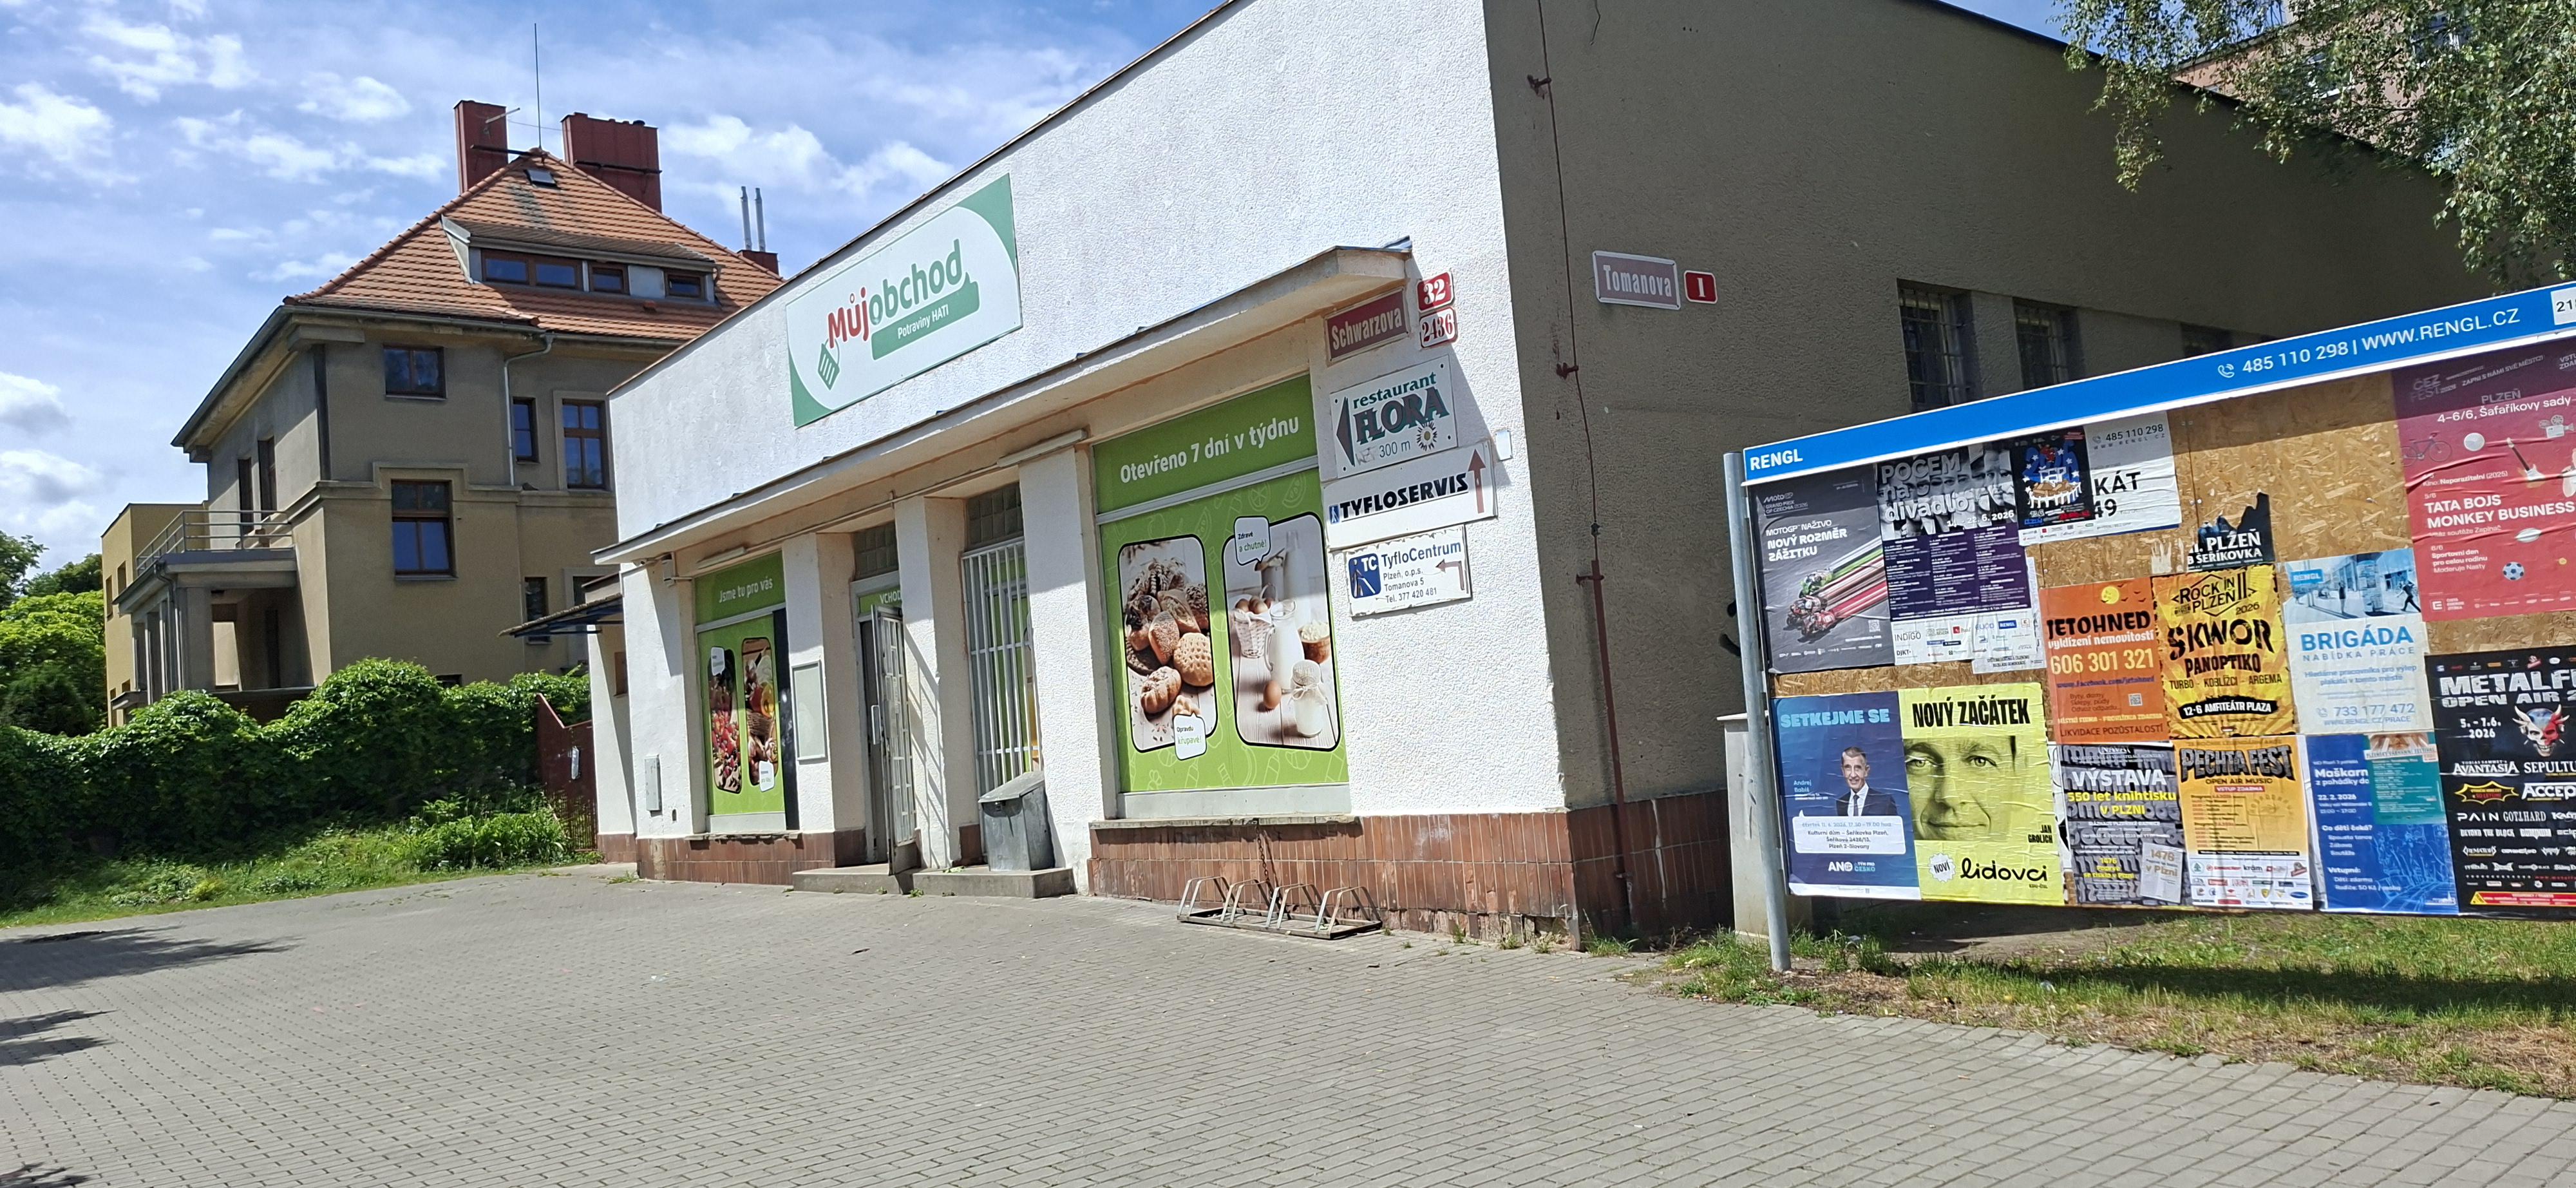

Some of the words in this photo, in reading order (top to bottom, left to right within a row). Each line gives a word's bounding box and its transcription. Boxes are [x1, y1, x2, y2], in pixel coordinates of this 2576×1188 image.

[1603, 265, 1672, 297] Tomanova
[1423, 279, 1446, 305] 32
[2557, 299, 2576, 312] 21
[898, 311, 930, 339] Potraviny
[932, 304, 949, 323] HATI
[1331, 308, 1402, 350] Schwarzova
[1421, 313, 1454, 342] 2436
[2242, 355, 2273, 374] 485
[2280, 348, 2311, 368] 110
[2316, 341, 2349, 361] 298
[2362, 307, 2520, 351] WWW.RENGL.CZ
[2505, 362, 2518, 372] SVÉ
[1353, 372, 1437, 409] restaurant
[2413, 374, 2441, 390] ČEZ
[2481, 388, 2521, 404] PLZEŇ
[2479, 401, 2539, 417] Šafaříkovy
[2543, 395, 2571, 407] sady
[1352, 387, 1450, 445] FLORA
[2105, 432, 2123, 442] 485
[2126, 428, 2143, 437] 110
[2146, 423, 2164, 434] 298
[1120, 448, 1188, 483] Otevřeno
[1191, 443, 1200, 463] 7
[1204, 434, 1229, 459] dní
[1234, 434, 1244, 450] v
[1249, 416, 1299, 448] týdnu
[1379, 442, 1397, 457] 300
[1401, 441, 1410, 452] m
[1750, 449, 1803, 471] RENGL
[2094, 470, 2141, 496] KÁT
[1340, 472, 1468, 519] TYFLOSERVIS
[1885, 483, 1910, 501] na
[1884, 492, 1969, 522] divadlo
[2424, 499, 2461, 513] TATA
[2463, 494, 2502, 510] BOJS
[1991, 510, 2015, 521] 2026
[2427, 510, 2494, 529] MONKEY
[2498, 501, 2575, 521] BUSINESS
[1801, 519, 1832, 532] NAŽIVO
[1767, 534, 1797, 550] NOVÝ
[1800, 527, 1848, 544] ROZMĚR
[2206, 528, 2262, 551] PLZEŇ
[1381, 542, 1462, 570] TyfloCentrum
[1768, 546, 1817, 562] ZÁŽITKU
[2196, 547, 2262, 564] ŠEŘÍKOVKA
[1361, 555, 1378, 571] TC
[1405, 568, 1423, 578] o.p.s.
[719, 585, 737, 604] Jsme
[738, 584, 746, 598] tu
[747, 581, 759, 599] pro
[760, 576, 773, 591] vás
[1385, 580, 1419, 592] Tomanova
[2179, 581, 2220, 604] ROCK
[1386, 594, 1397, 604] Tel.
[1399, 592, 1410, 602] 377
[1412, 590, 1424, 599] 420
[1426, 587, 1437, 597] 481
[2235, 602, 2260, 616] 2026
[2047, 610, 2151, 640] JETOHNED
[1895, 631, 1922, 642] INDIGO
[2048, 635, 2092, 650] vyklízení
[2094, 629, 2154, 646] nemovitostí
[2300, 624, 2414, 652] BRIGÁDA
[2050, 653, 2083, 675] 606
[2088, 651, 2118, 673] 301
[2124, 647, 2154, 669] 321
[2302, 651, 2362, 662] NABÍDKA
[2370, 646, 2415, 657] PRÁCE
[2184, 653, 2262, 678] PANOPTIKO
[2382, 666, 2395, 675] pro
[2170, 680, 2194, 690] TURBO
[2248, 673, 2282, 685] ARGEMA
[2439, 669, 2576, 696] METALF
[2204, 699, 2246, 713] AMFITEÁTR
[2246, 701, 2272, 713] PLAZA
[2442, 694, 2508, 708] OPEN
[2516, 691, 2561, 704] AIR
[1780, 709, 1865, 728] SETKEJME
[1868, 708, 1890, 723] SE
[1912, 696, 1954, 728] NOVÝ
[1957, 694, 2031, 725] ZAČÁTEK
[2335, 706, 2358, 717] 733
[2363, 704, 2385, 715] 177
[2390, 703, 2415, 714] 472
[2060, 725, 2100, 737] LIKVIDACE
[2103, 723, 2163, 736] POZŮSTALOSTÍ
[2460, 718, 2470, 728] 5.
[2468, 729, 2496, 738] 2026
[2179, 748, 2249, 783] PECHTA
[2248, 744, 2297, 781] FEST
[2452, 761, 2520, 775] AVANTASIA
[2524, 761, 2576, 773] SEPULTU
[2072, 767, 2167, 787] VÝSTAVA
[2314, 767, 2369, 778] Maškarn
[2067, 792, 2090, 801] 550
[2093, 791, 2112, 801] let
[2114, 790, 2177, 801] knihtisku
[2521, 783, 2576, 800] ACCEP
[2457, 812, 2499, 821] PAIN
[2040, 824, 2052, 834] JAN
[2028, 834, 2053, 843] GROLICH
[2150, 848, 2175, 862] 1476
[1828, 861, 1853, 872] ANO
[1933, 859, 1951, 874] NOVÍ
[1960, 857, 2048, 882] lidovci
